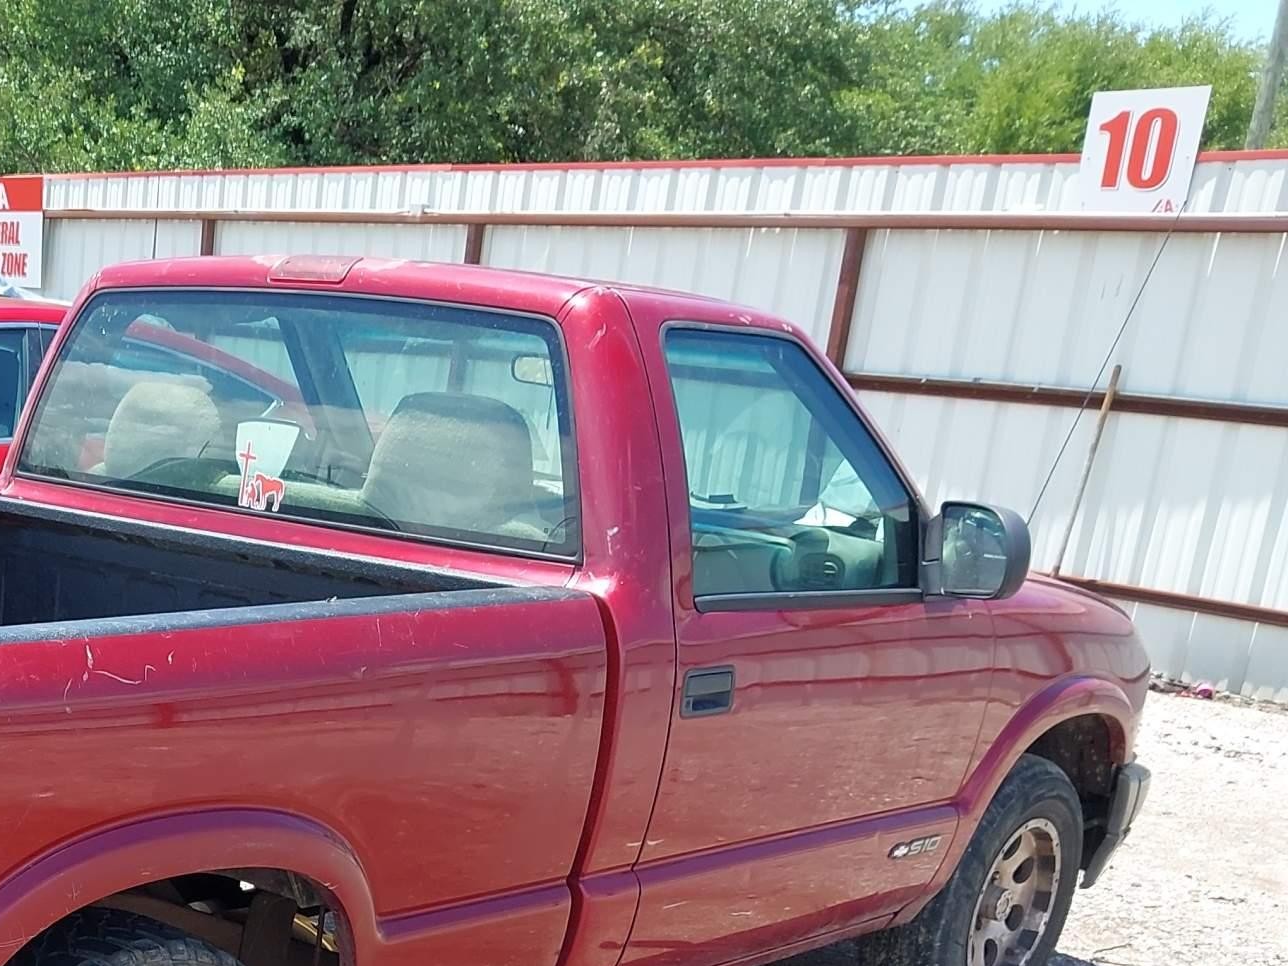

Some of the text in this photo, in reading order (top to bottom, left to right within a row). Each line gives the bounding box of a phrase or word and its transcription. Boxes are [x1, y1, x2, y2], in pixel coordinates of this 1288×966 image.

[1099, 107, 1179, 190] 10
[0, 253, 28, 277] ZONE
[908, 836, 943, 856] S10
